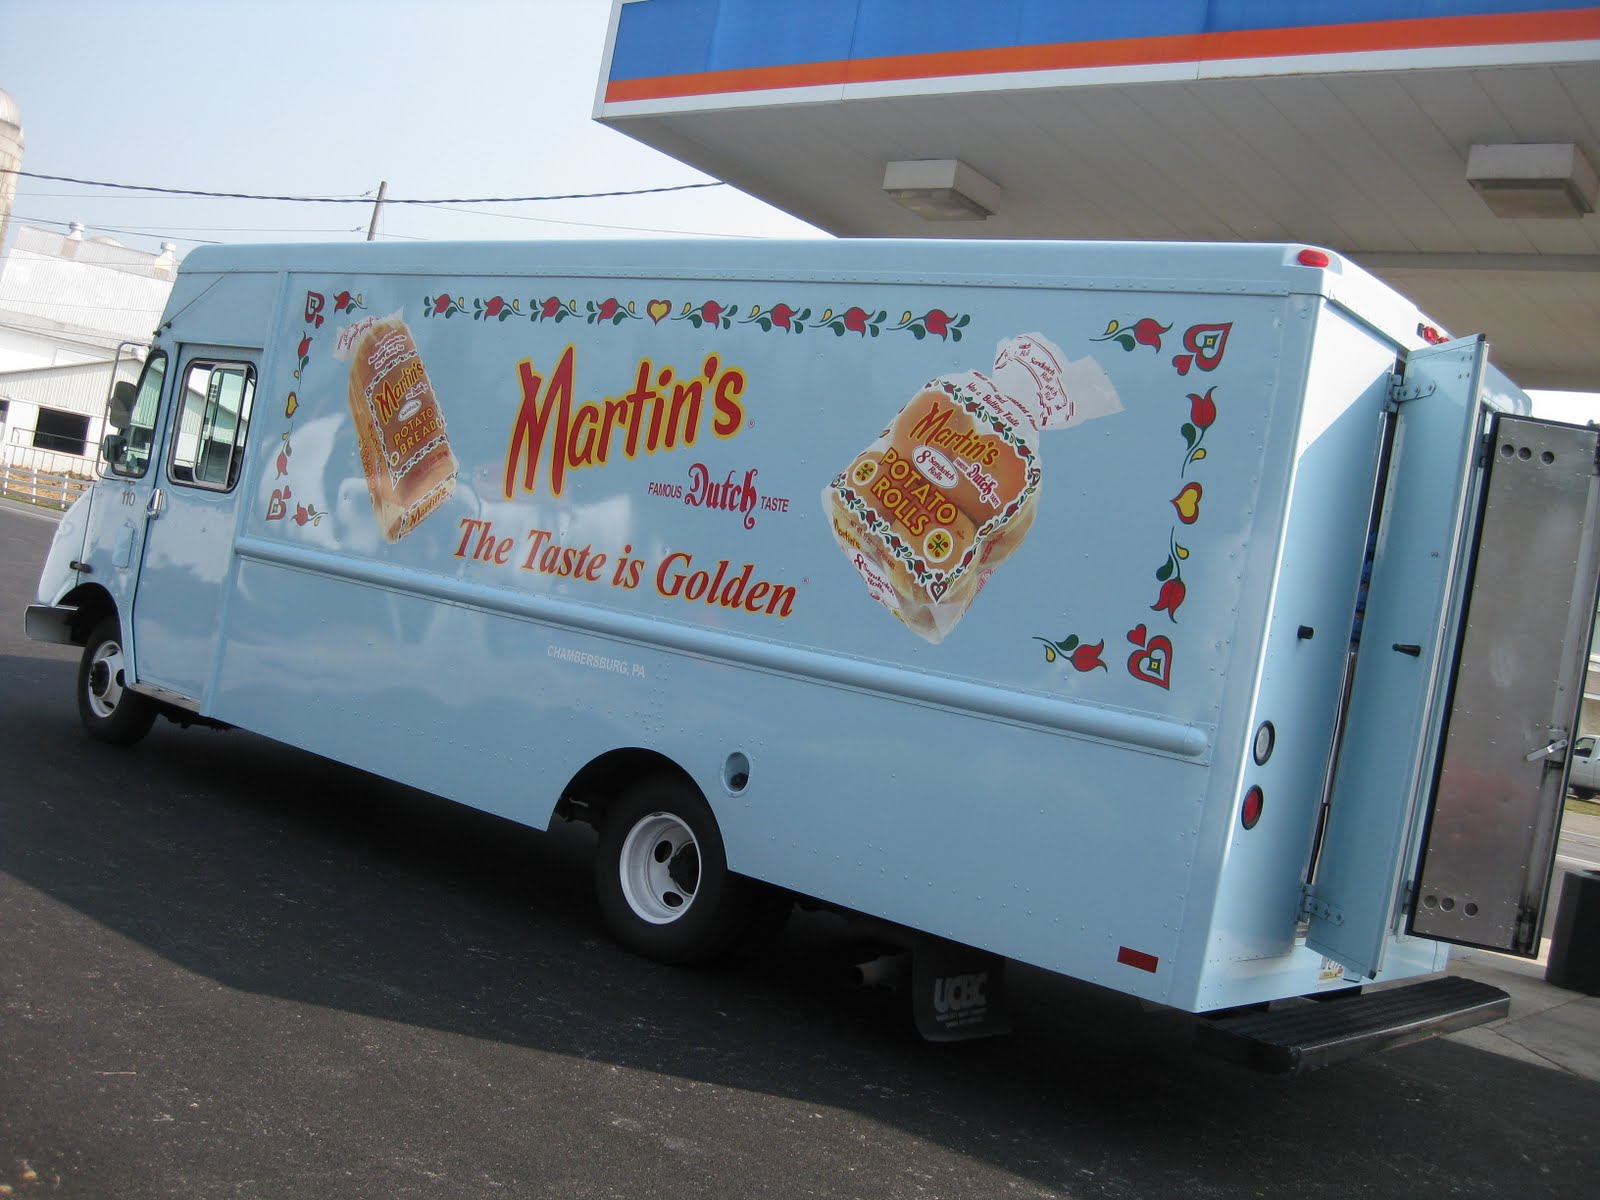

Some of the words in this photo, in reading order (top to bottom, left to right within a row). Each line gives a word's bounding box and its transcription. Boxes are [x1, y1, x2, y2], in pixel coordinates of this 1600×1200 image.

[375, 362, 425, 425] Martin's
[504, 344, 745, 500] Martin's
[393, 407, 434, 446] POTATO
[399, 420, 438, 456] BREAD
[908, 401, 999, 466] Martin's
[879, 446, 958, 525] POTATO
[916, 449, 931, 464] 8
[929, 457, 955, 481] Sandwich
[967, 463, 997, 502] Dutch
[122, 490, 136, 507] 110
[648, 482, 683, 499] FAMOUS
[685, 463, 758, 530] Dutch
[761, 496, 790, 513] TASTE
[870, 475, 931, 536] ROLLS
[454, 518, 514, 565] The
[521, 529, 608, 582] Taste
[611, 544, 645, 590] is
[655, 552, 797, 618] Golden
[547, 645, 630, 676] CHAMBERSBURG,
[631, 663, 646, 678] PA
